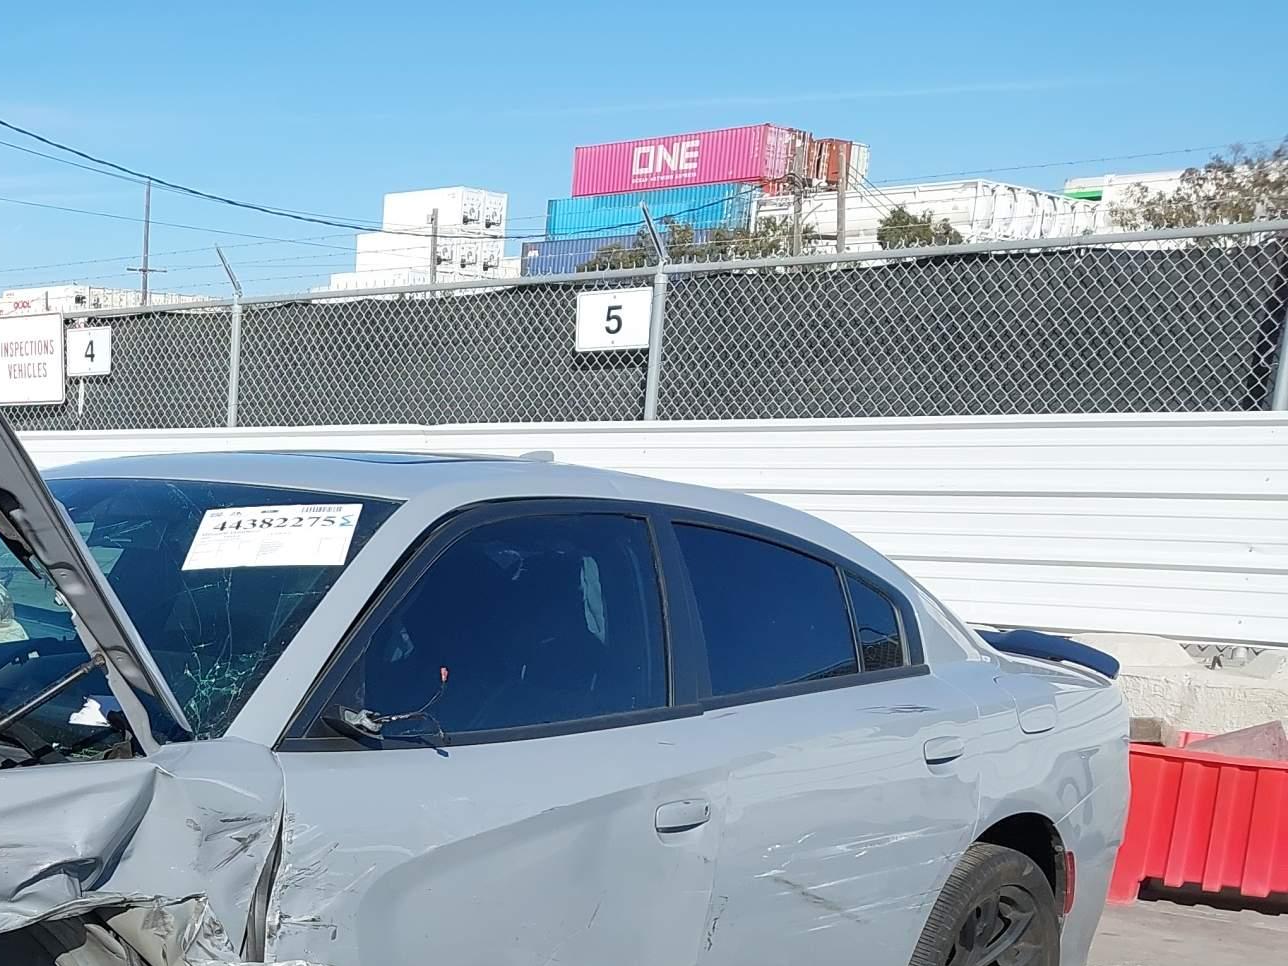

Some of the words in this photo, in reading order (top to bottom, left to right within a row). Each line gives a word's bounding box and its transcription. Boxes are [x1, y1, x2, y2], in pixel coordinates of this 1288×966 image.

[632, 140, 699, 175] ONE
[605, 304, 623, 335] 5
[0, 339, 55, 358] INSPECTIONS
[84, 339, 95, 362] 4
[7, 362, 48, 380] VEHICLES
[214, 516, 337, 531] 44382275
